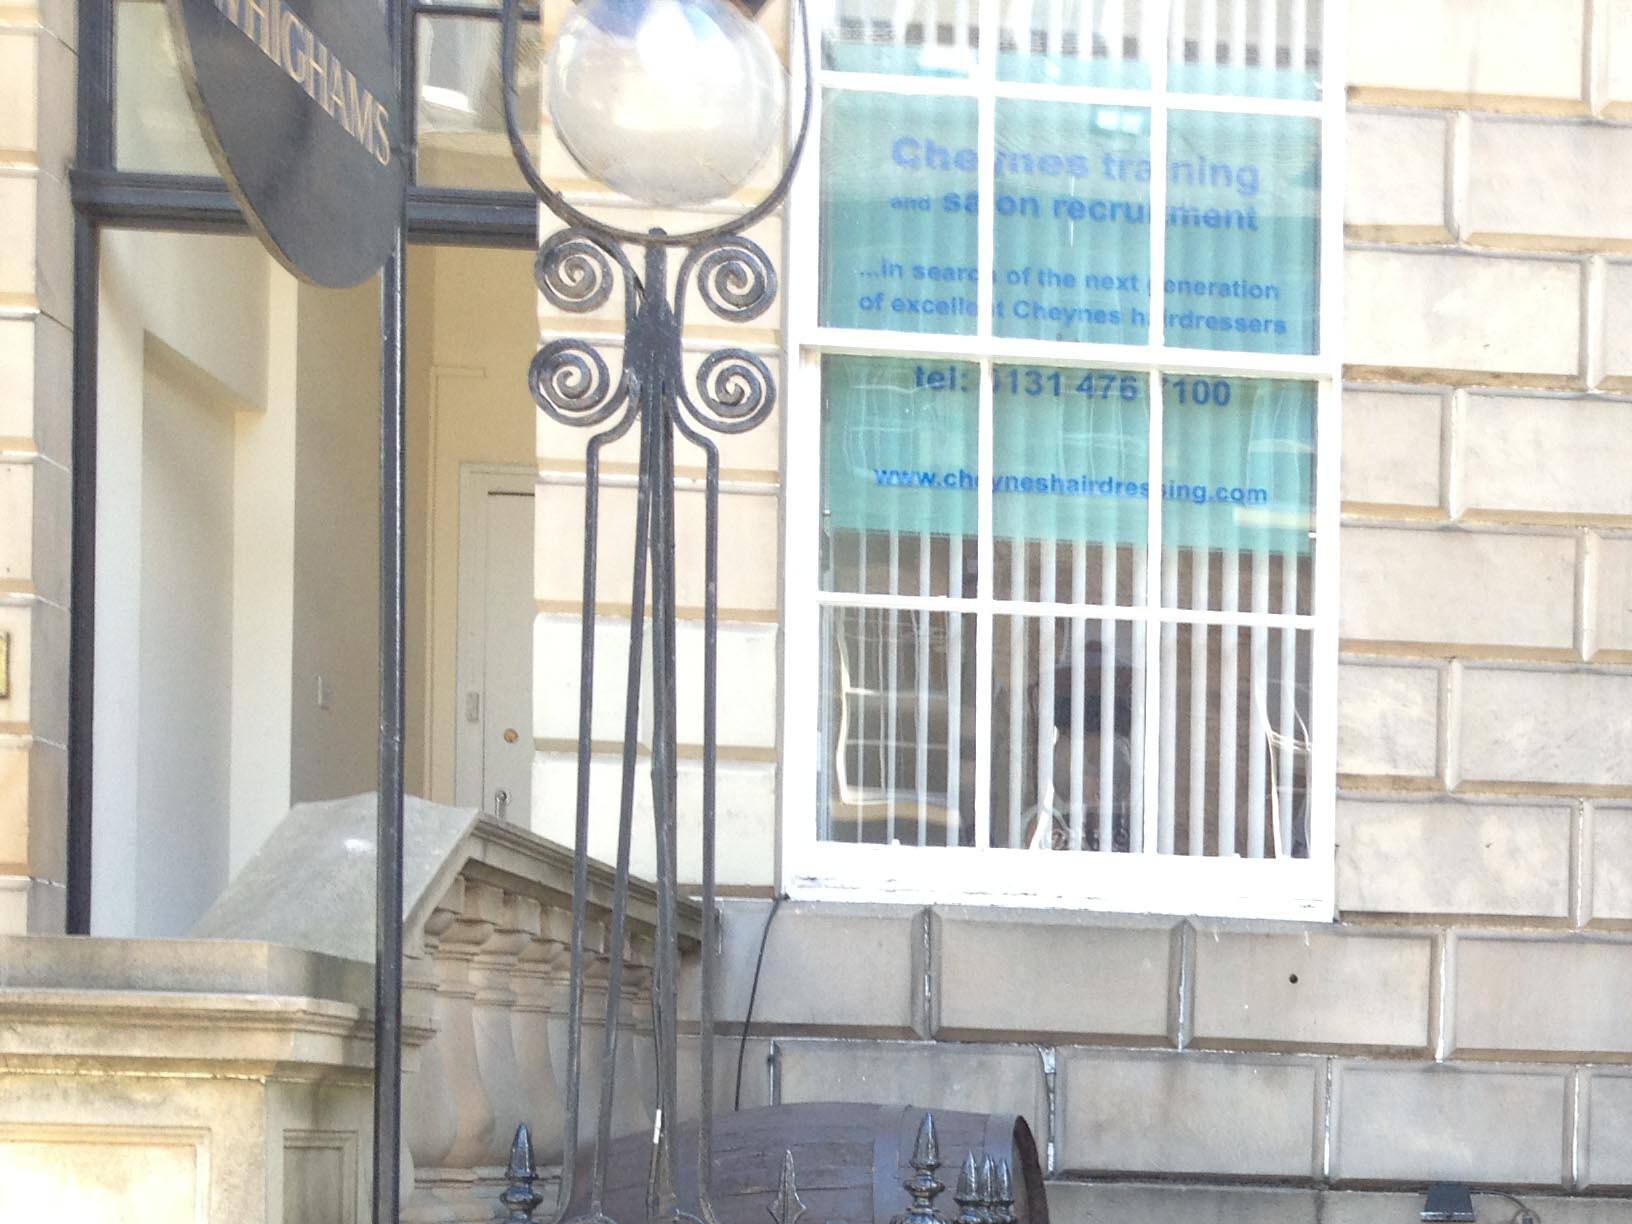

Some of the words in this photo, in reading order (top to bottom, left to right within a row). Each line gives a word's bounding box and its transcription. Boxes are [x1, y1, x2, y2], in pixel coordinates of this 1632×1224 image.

[214, 0, 391, 167] HIGHAMS
[1102, 152, 1261, 197] traning
[889, 195, 931, 212] and
[942, 192, 1041, 218] saon
[1052, 196, 1258, 232] recrument
[1006, 266, 1032, 287] of
[1037, 267, 1077, 290] the
[1085, 272, 1140, 292] next
[1147, 277, 1281, 301] eneration
[859, 292, 885, 312] of
[891, 297, 1004, 318] excellet
[1013, 299, 1121, 327] Cheynes
[914, 365, 969, 393] tel:
[1075, 373, 1140, 402] 476
[1161, 377, 1232, 408] 100
